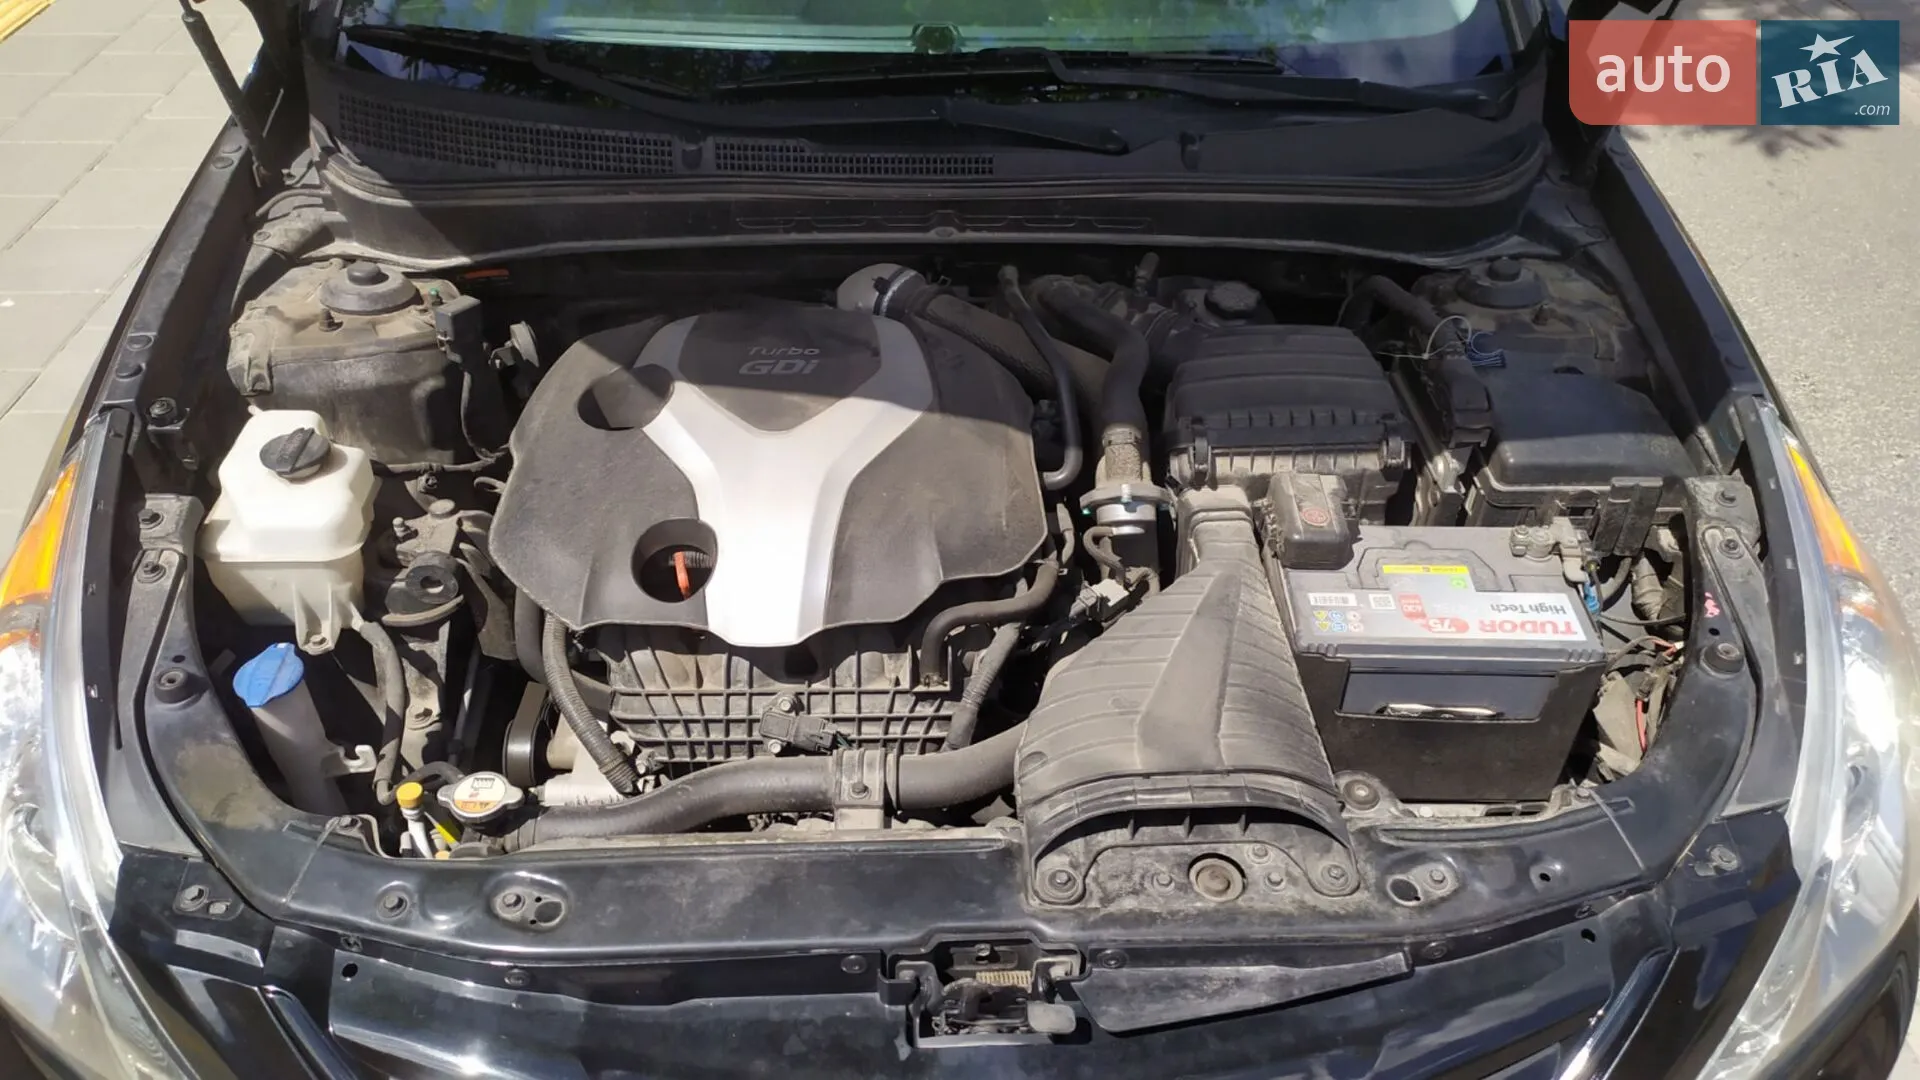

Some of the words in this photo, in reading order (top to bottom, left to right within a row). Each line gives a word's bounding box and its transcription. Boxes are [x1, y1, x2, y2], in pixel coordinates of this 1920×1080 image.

[747, 346, 820, 356] Turbo
[739, 359, 820, 375] GDi
[1490, 603, 1528, 615] Tech
[1528, 602, 1567, 616] High
[1427, 618, 1457, 633] 75
[1478, 619, 1578, 636] TUDOR
